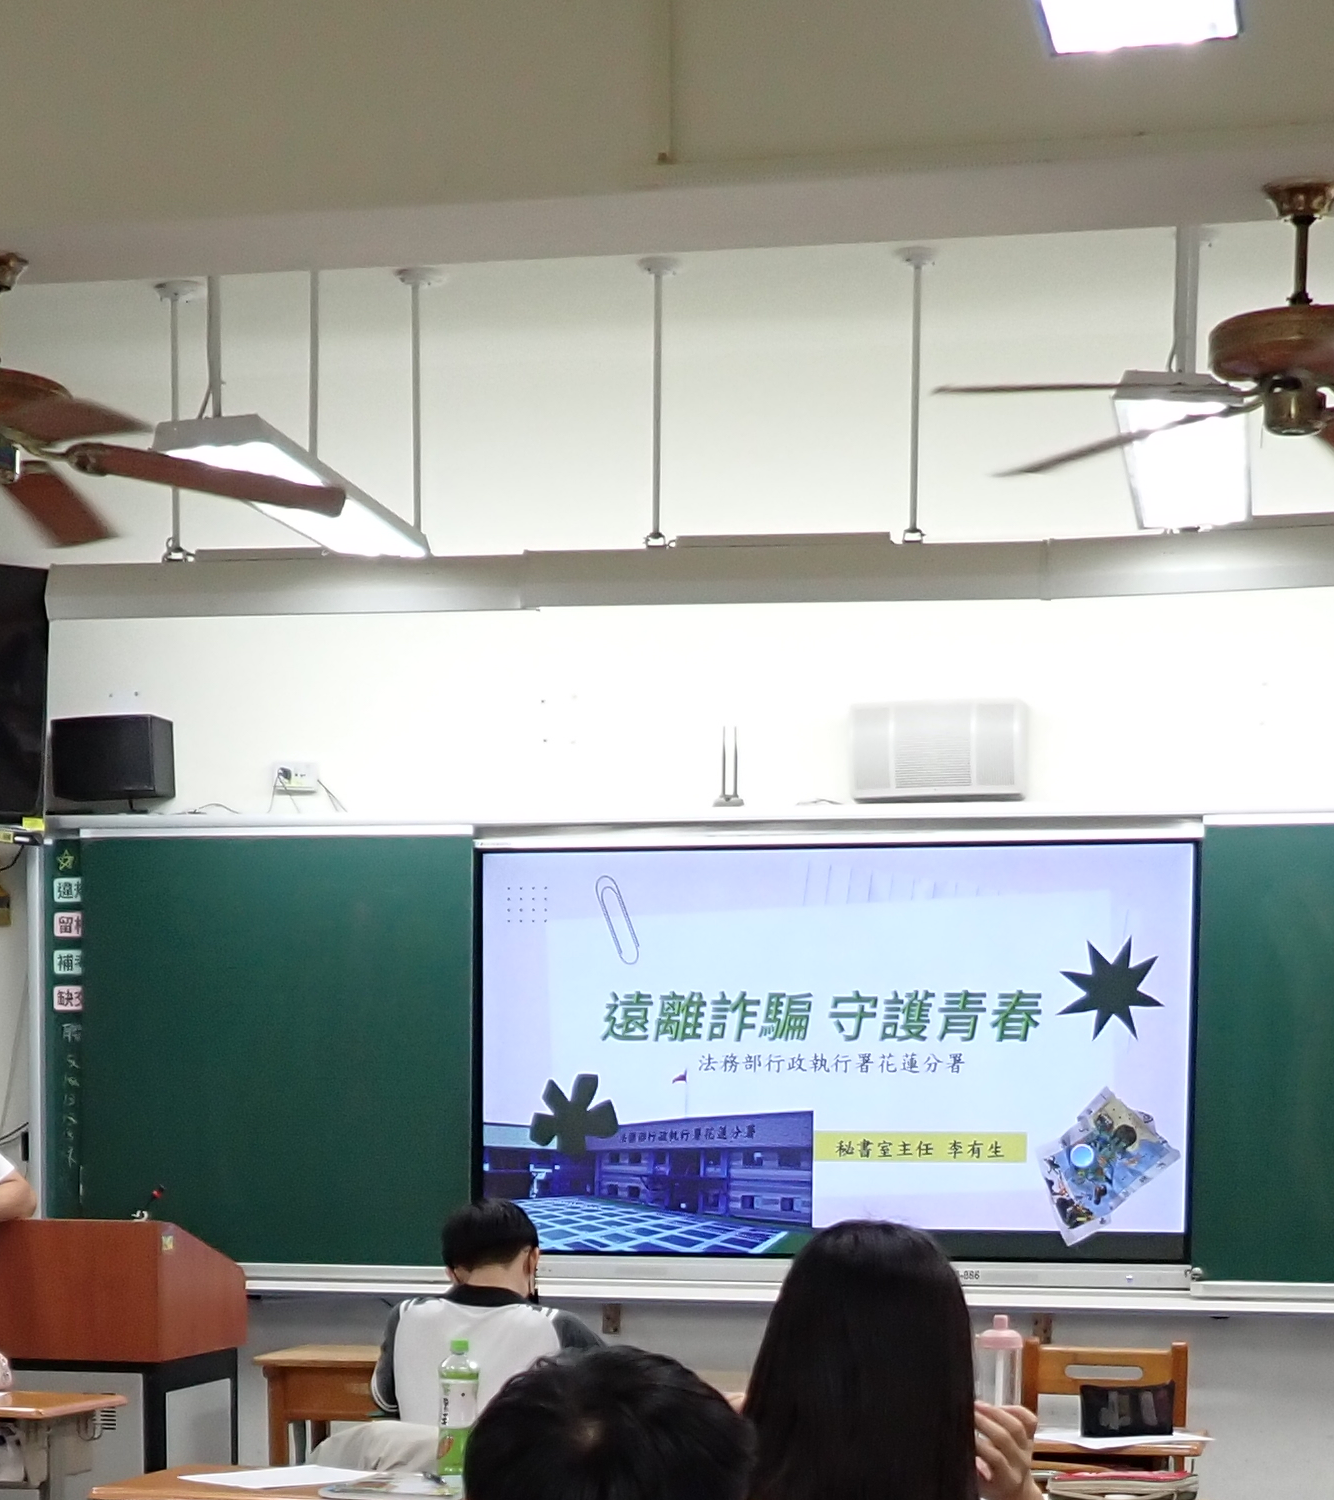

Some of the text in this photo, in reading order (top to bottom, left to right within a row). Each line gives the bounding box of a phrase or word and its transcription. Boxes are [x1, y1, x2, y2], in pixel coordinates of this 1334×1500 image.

[600, 988, 1043, 1043] 遠離詐騙 守護青春
[697, 1052, 966, 1074] 法務部行政執行署花蓮分署
[835, 1139, 1005, 1158] 秘書室主任 李有生
